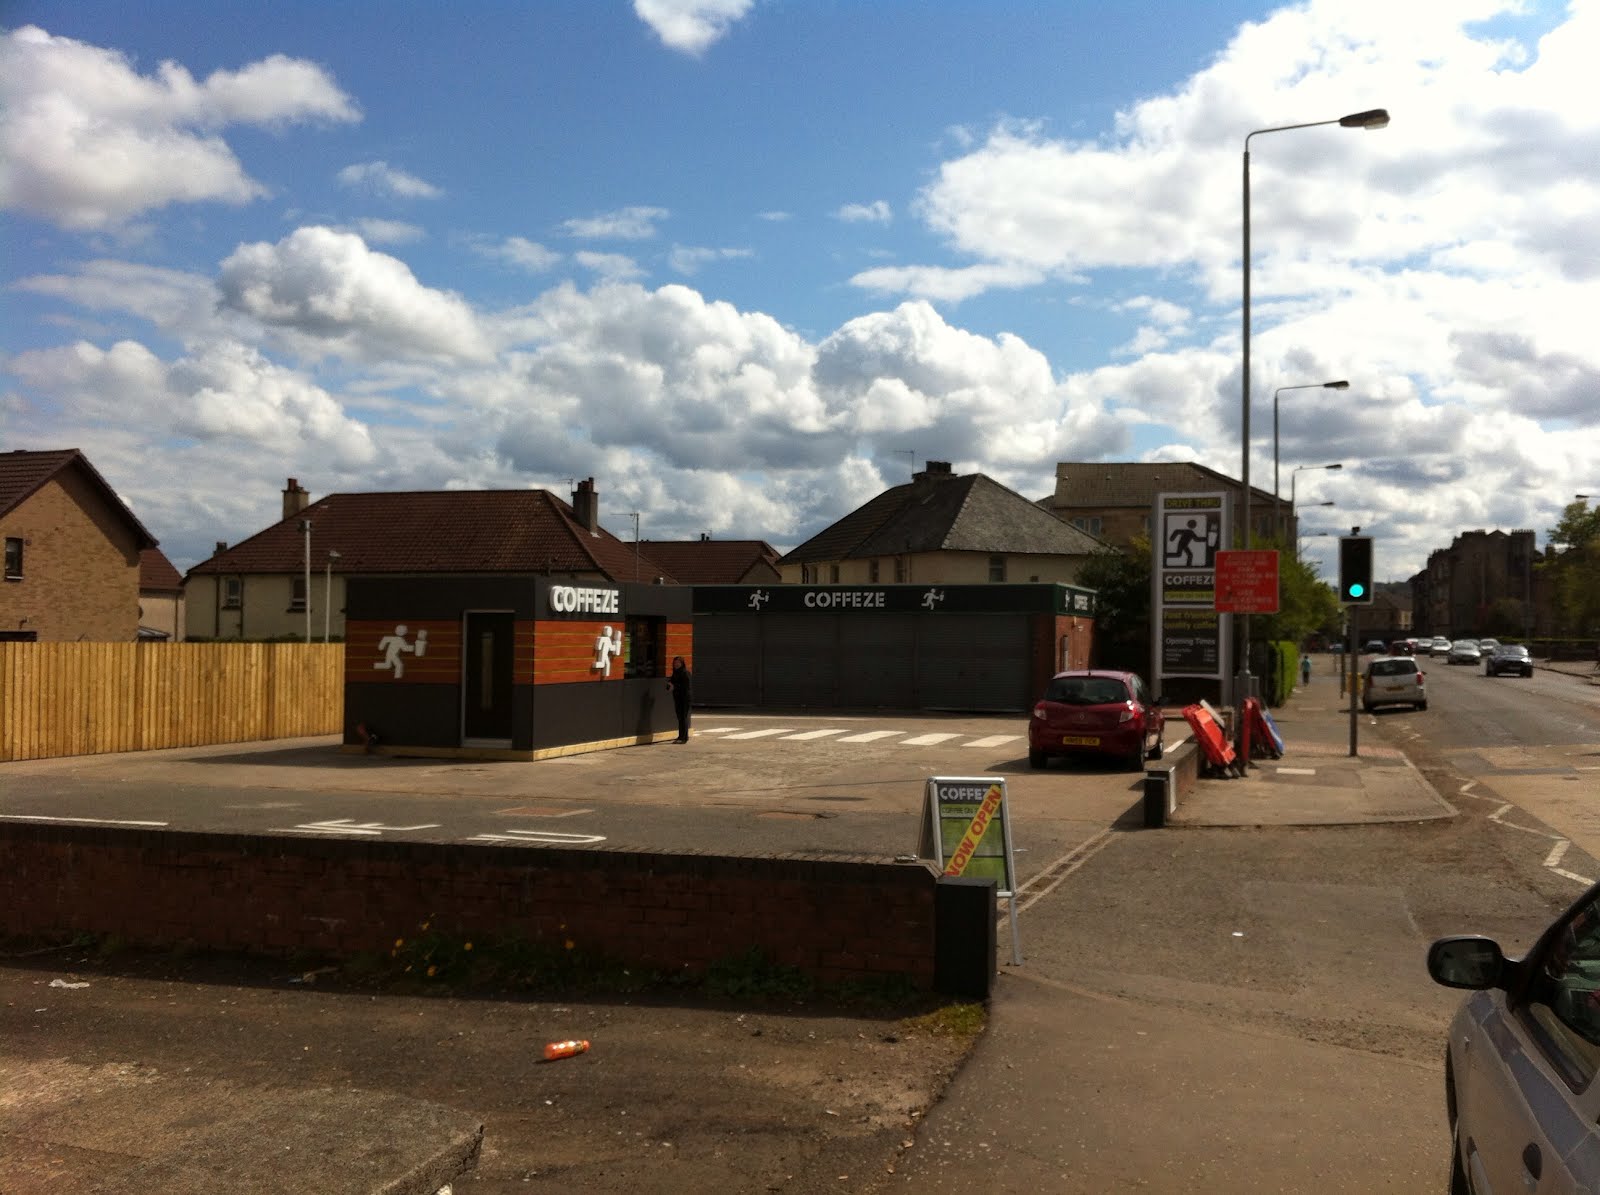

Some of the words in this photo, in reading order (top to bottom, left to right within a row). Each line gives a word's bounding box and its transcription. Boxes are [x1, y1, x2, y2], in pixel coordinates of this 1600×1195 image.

[550, 585, 619, 614] COFFEZE
[804, 591, 885, 608] COFFEZE
[1165, 637, 1194, 646] Opening
[940, 787, 990, 801] COFFE
[944, 836, 975, 876] NOW
[971, 788, 1001, 836] OPEN
